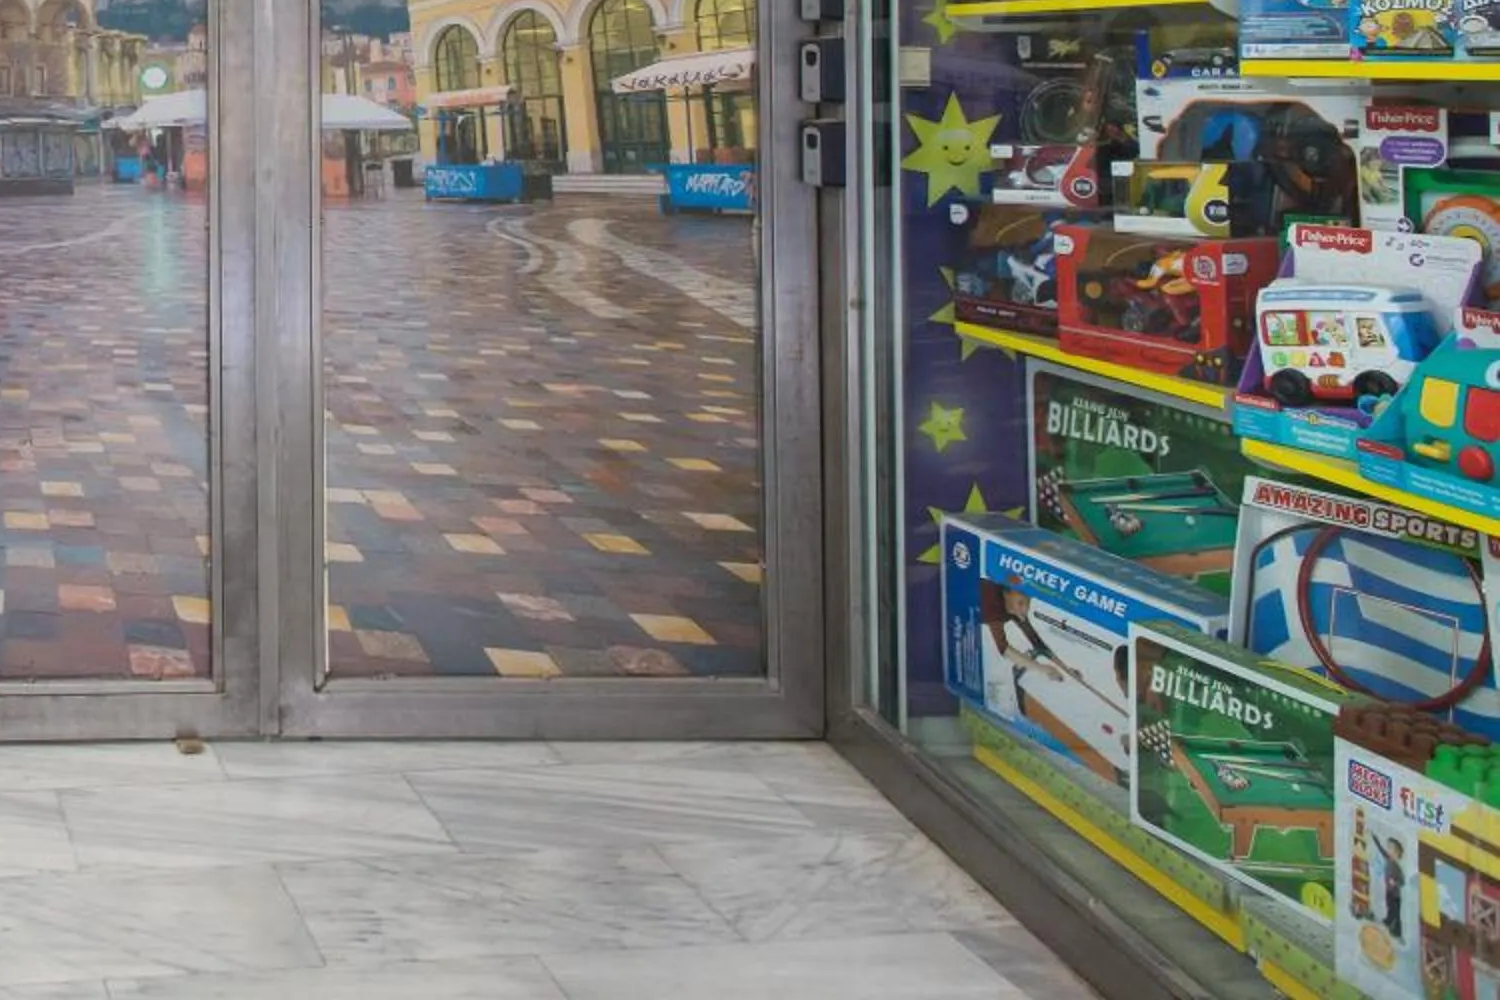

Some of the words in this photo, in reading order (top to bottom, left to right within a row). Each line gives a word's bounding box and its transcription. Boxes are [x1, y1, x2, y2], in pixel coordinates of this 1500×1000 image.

[1047, 401, 1171, 456] BILLIARDS
[1253, 482, 1371, 529] AMAZING
[1374, 507, 1480, 549] SPORTS
[999, 553, 1071, 593] HOCKEY
[1074, 585, 1128, 618] GAME
[1150, 664, 1275, 730] BILLIARDS
